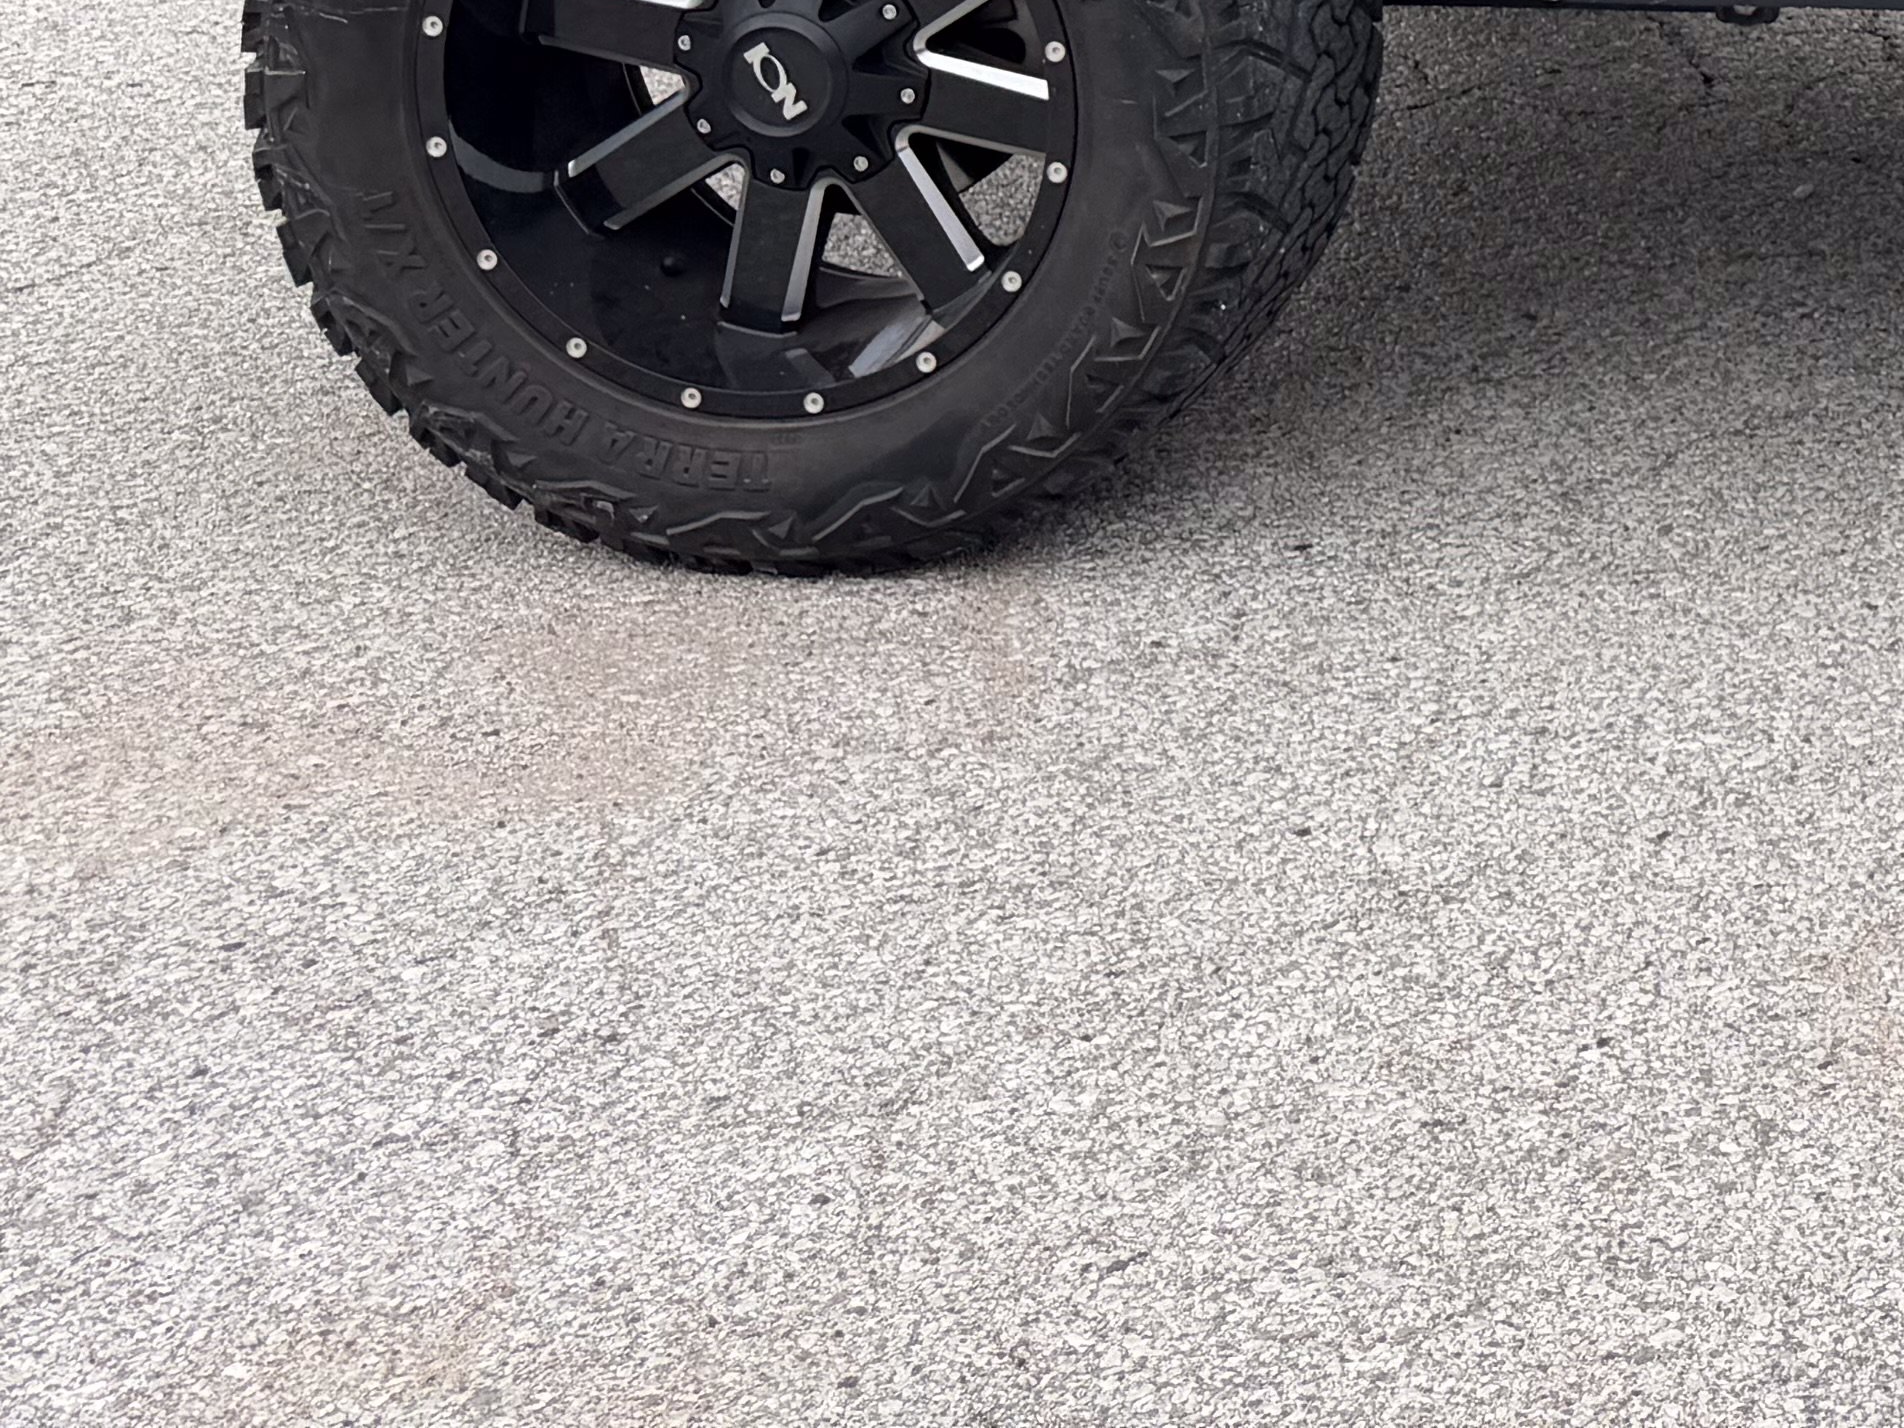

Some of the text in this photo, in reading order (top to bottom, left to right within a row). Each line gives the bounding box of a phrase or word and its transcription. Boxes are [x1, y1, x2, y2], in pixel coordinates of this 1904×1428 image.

[743, 41, 809, 122] ION
[405, 280, 592, 447] HUNTER
[600, 421, 773, 493] TERRA
